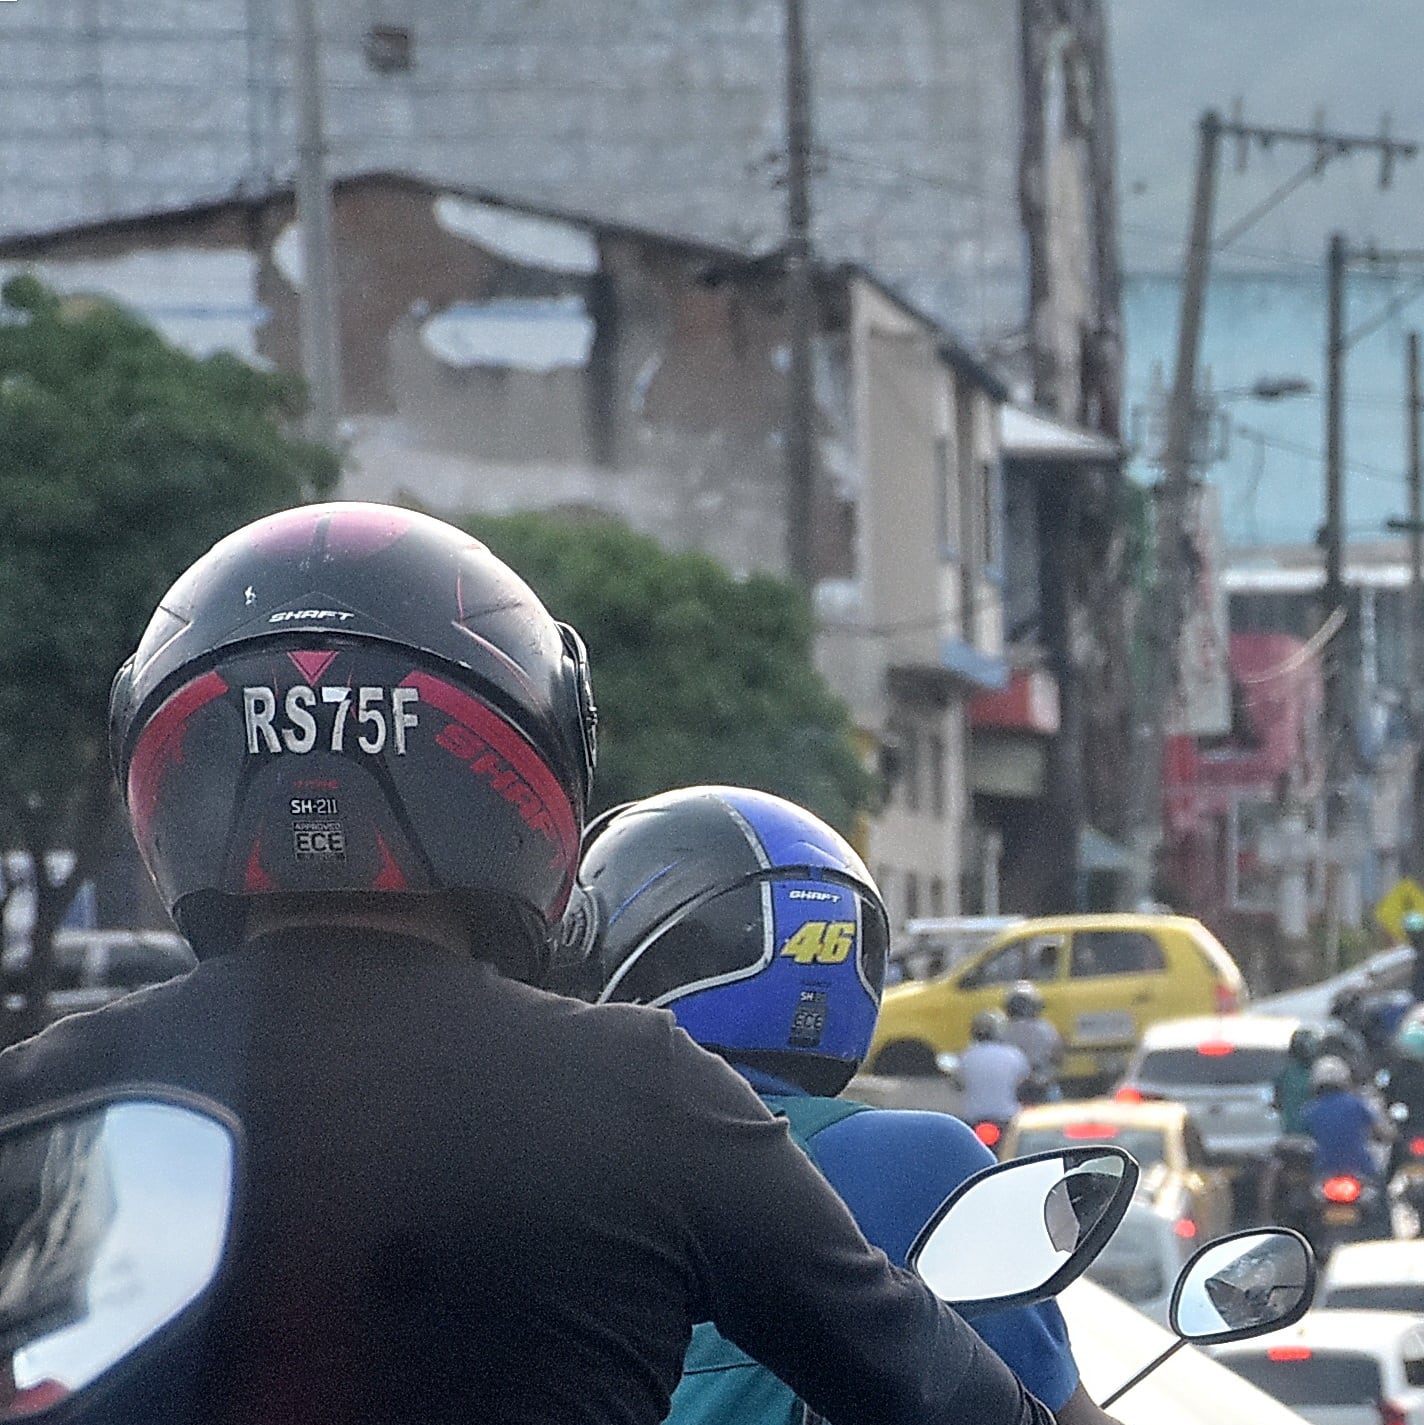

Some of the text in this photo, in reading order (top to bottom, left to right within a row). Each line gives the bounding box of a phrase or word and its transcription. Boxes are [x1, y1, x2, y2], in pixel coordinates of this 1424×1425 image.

[268, 609, 355, 623] SHAFT
[243, 685, 419, 755] RS75F
[290, 799, 338, 814] SH-211
[296, 832, 343, 851] ECE
[780, 920, 857, 964] 46
